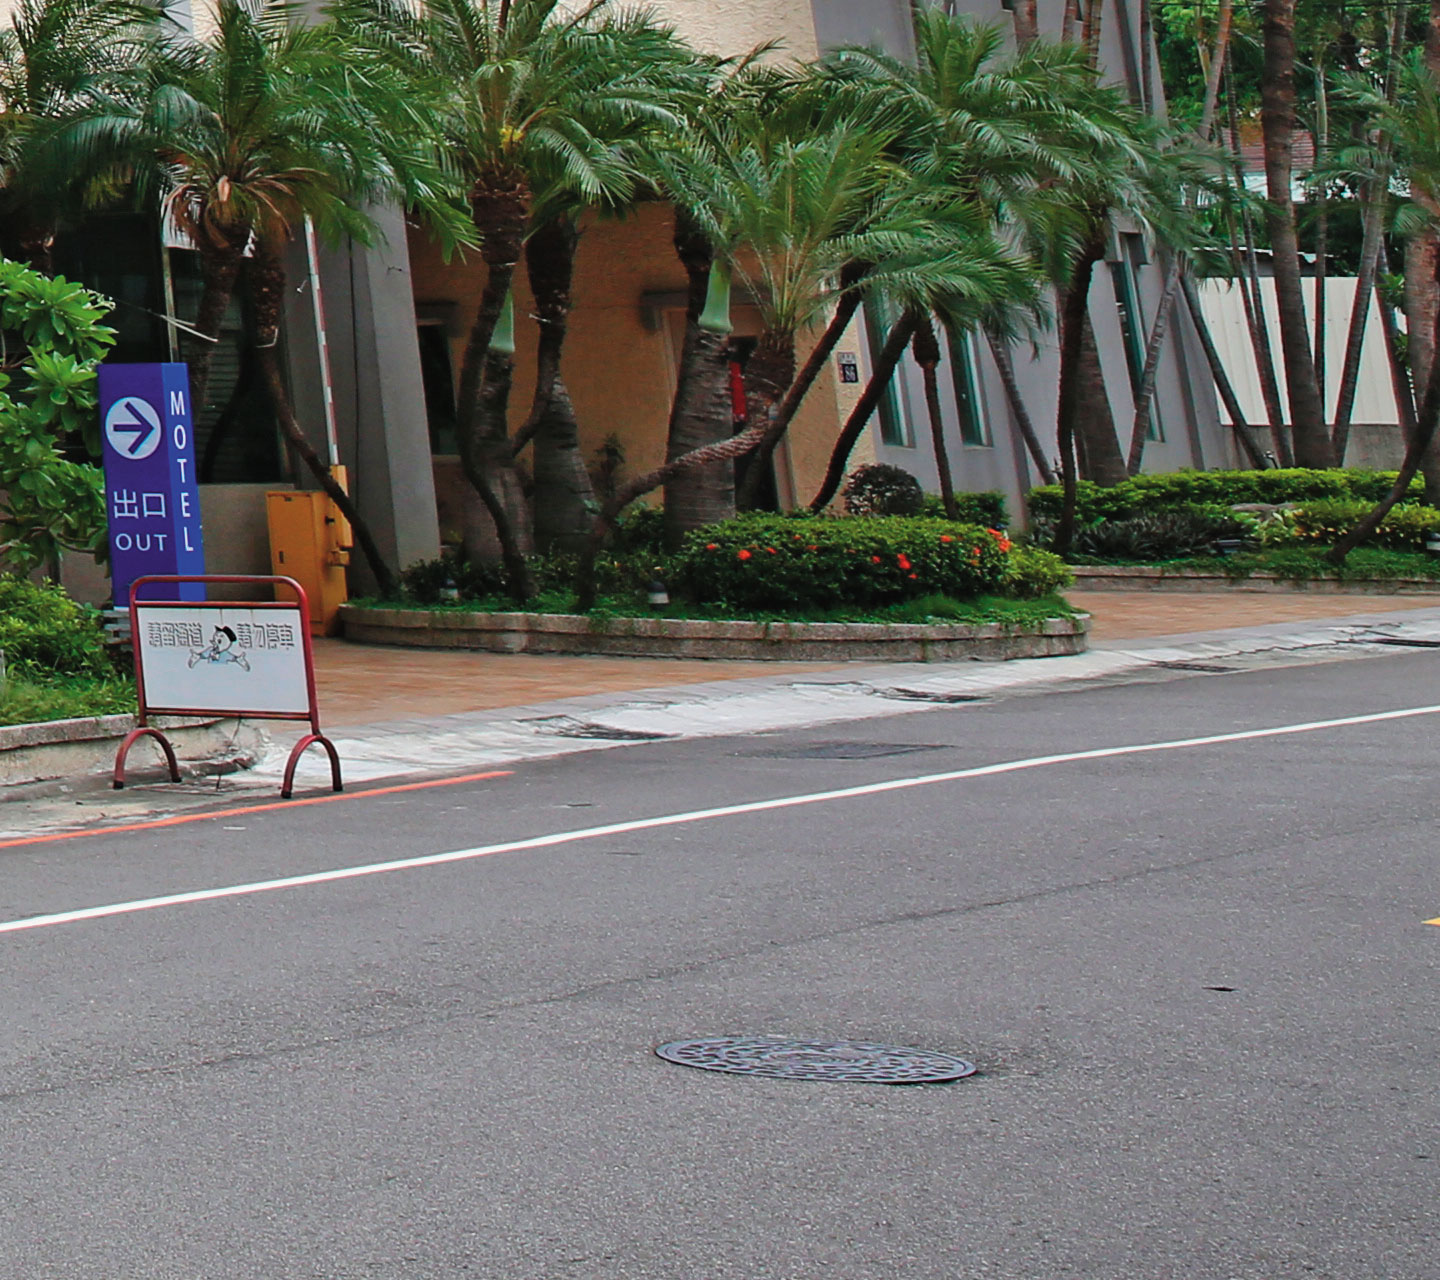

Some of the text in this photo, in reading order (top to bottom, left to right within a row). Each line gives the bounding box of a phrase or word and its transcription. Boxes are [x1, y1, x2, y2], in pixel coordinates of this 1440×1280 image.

[170, 391, 193, 552] MOTEL
[113, 489, 167, 519] 出口
[115, 533, 167, 552] OUT
